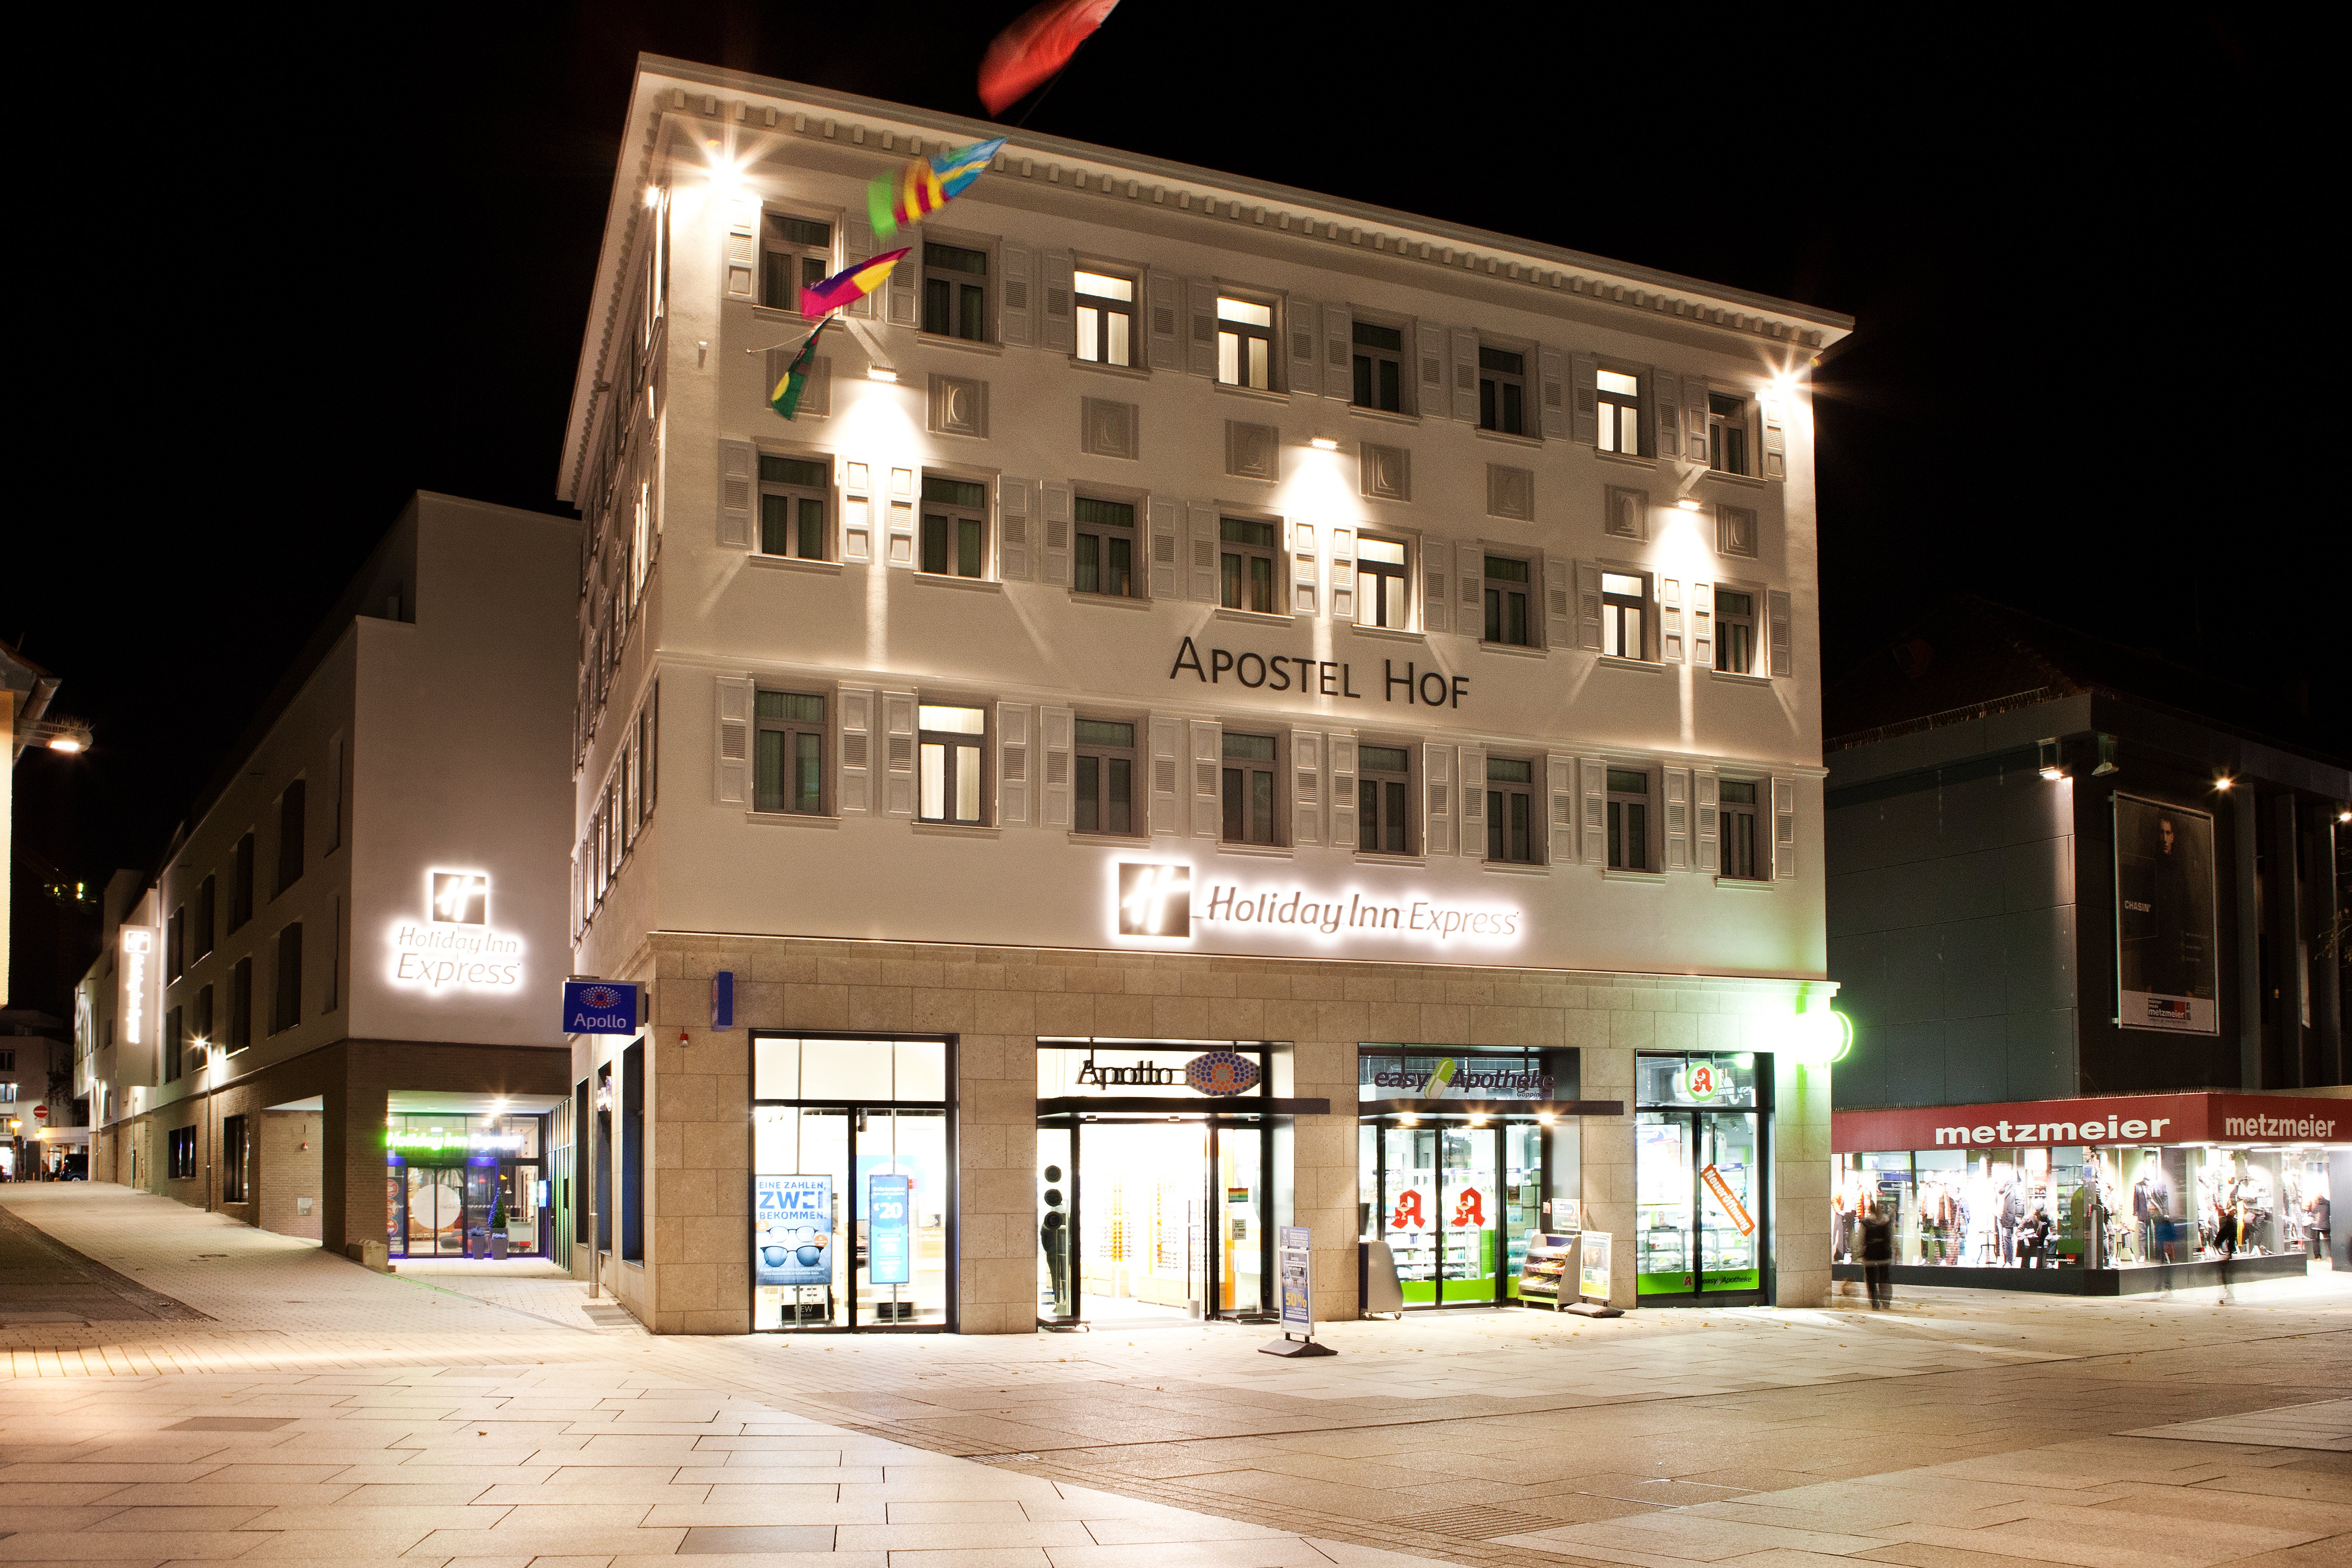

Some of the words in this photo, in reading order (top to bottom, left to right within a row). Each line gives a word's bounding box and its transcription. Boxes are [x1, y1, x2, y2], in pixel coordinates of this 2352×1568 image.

[1207, 885, 1342, 934] Holiday
[1349, 893, 1400, 929] Inn
[1408, 902, 1518, 939] Express
[399, 926, 482, 954] Holiday
[485, 933, 518, 953] Inn
[397, 952, 518, 988] Express
[574, 1013, 627, 1030] Apollo
[2148, 1009, 2185, 1019] metzmeier
[1075, 1060, 1173, 1091] Apollo
[1374, 1071, 1427, 1093] easy
[1448, 1069, 1557, 1093] Apotheke
[1935, 1115, 2170, 1145] metzmeier
[2225, 1114, 2336, 1138] metzmeier
[386, 1131, 444, 1150] Holiday
[784, 1181, 826, 1191] ZAHLEN,
[759, 1191, 823, 1209] ZWEI
[1705, 1169, 1751, 1231] Neueröffnung
[759, 1211, 827, 1220] BEKOMMEN.
[1723, 1276, 1752, 1284] Apotheke
